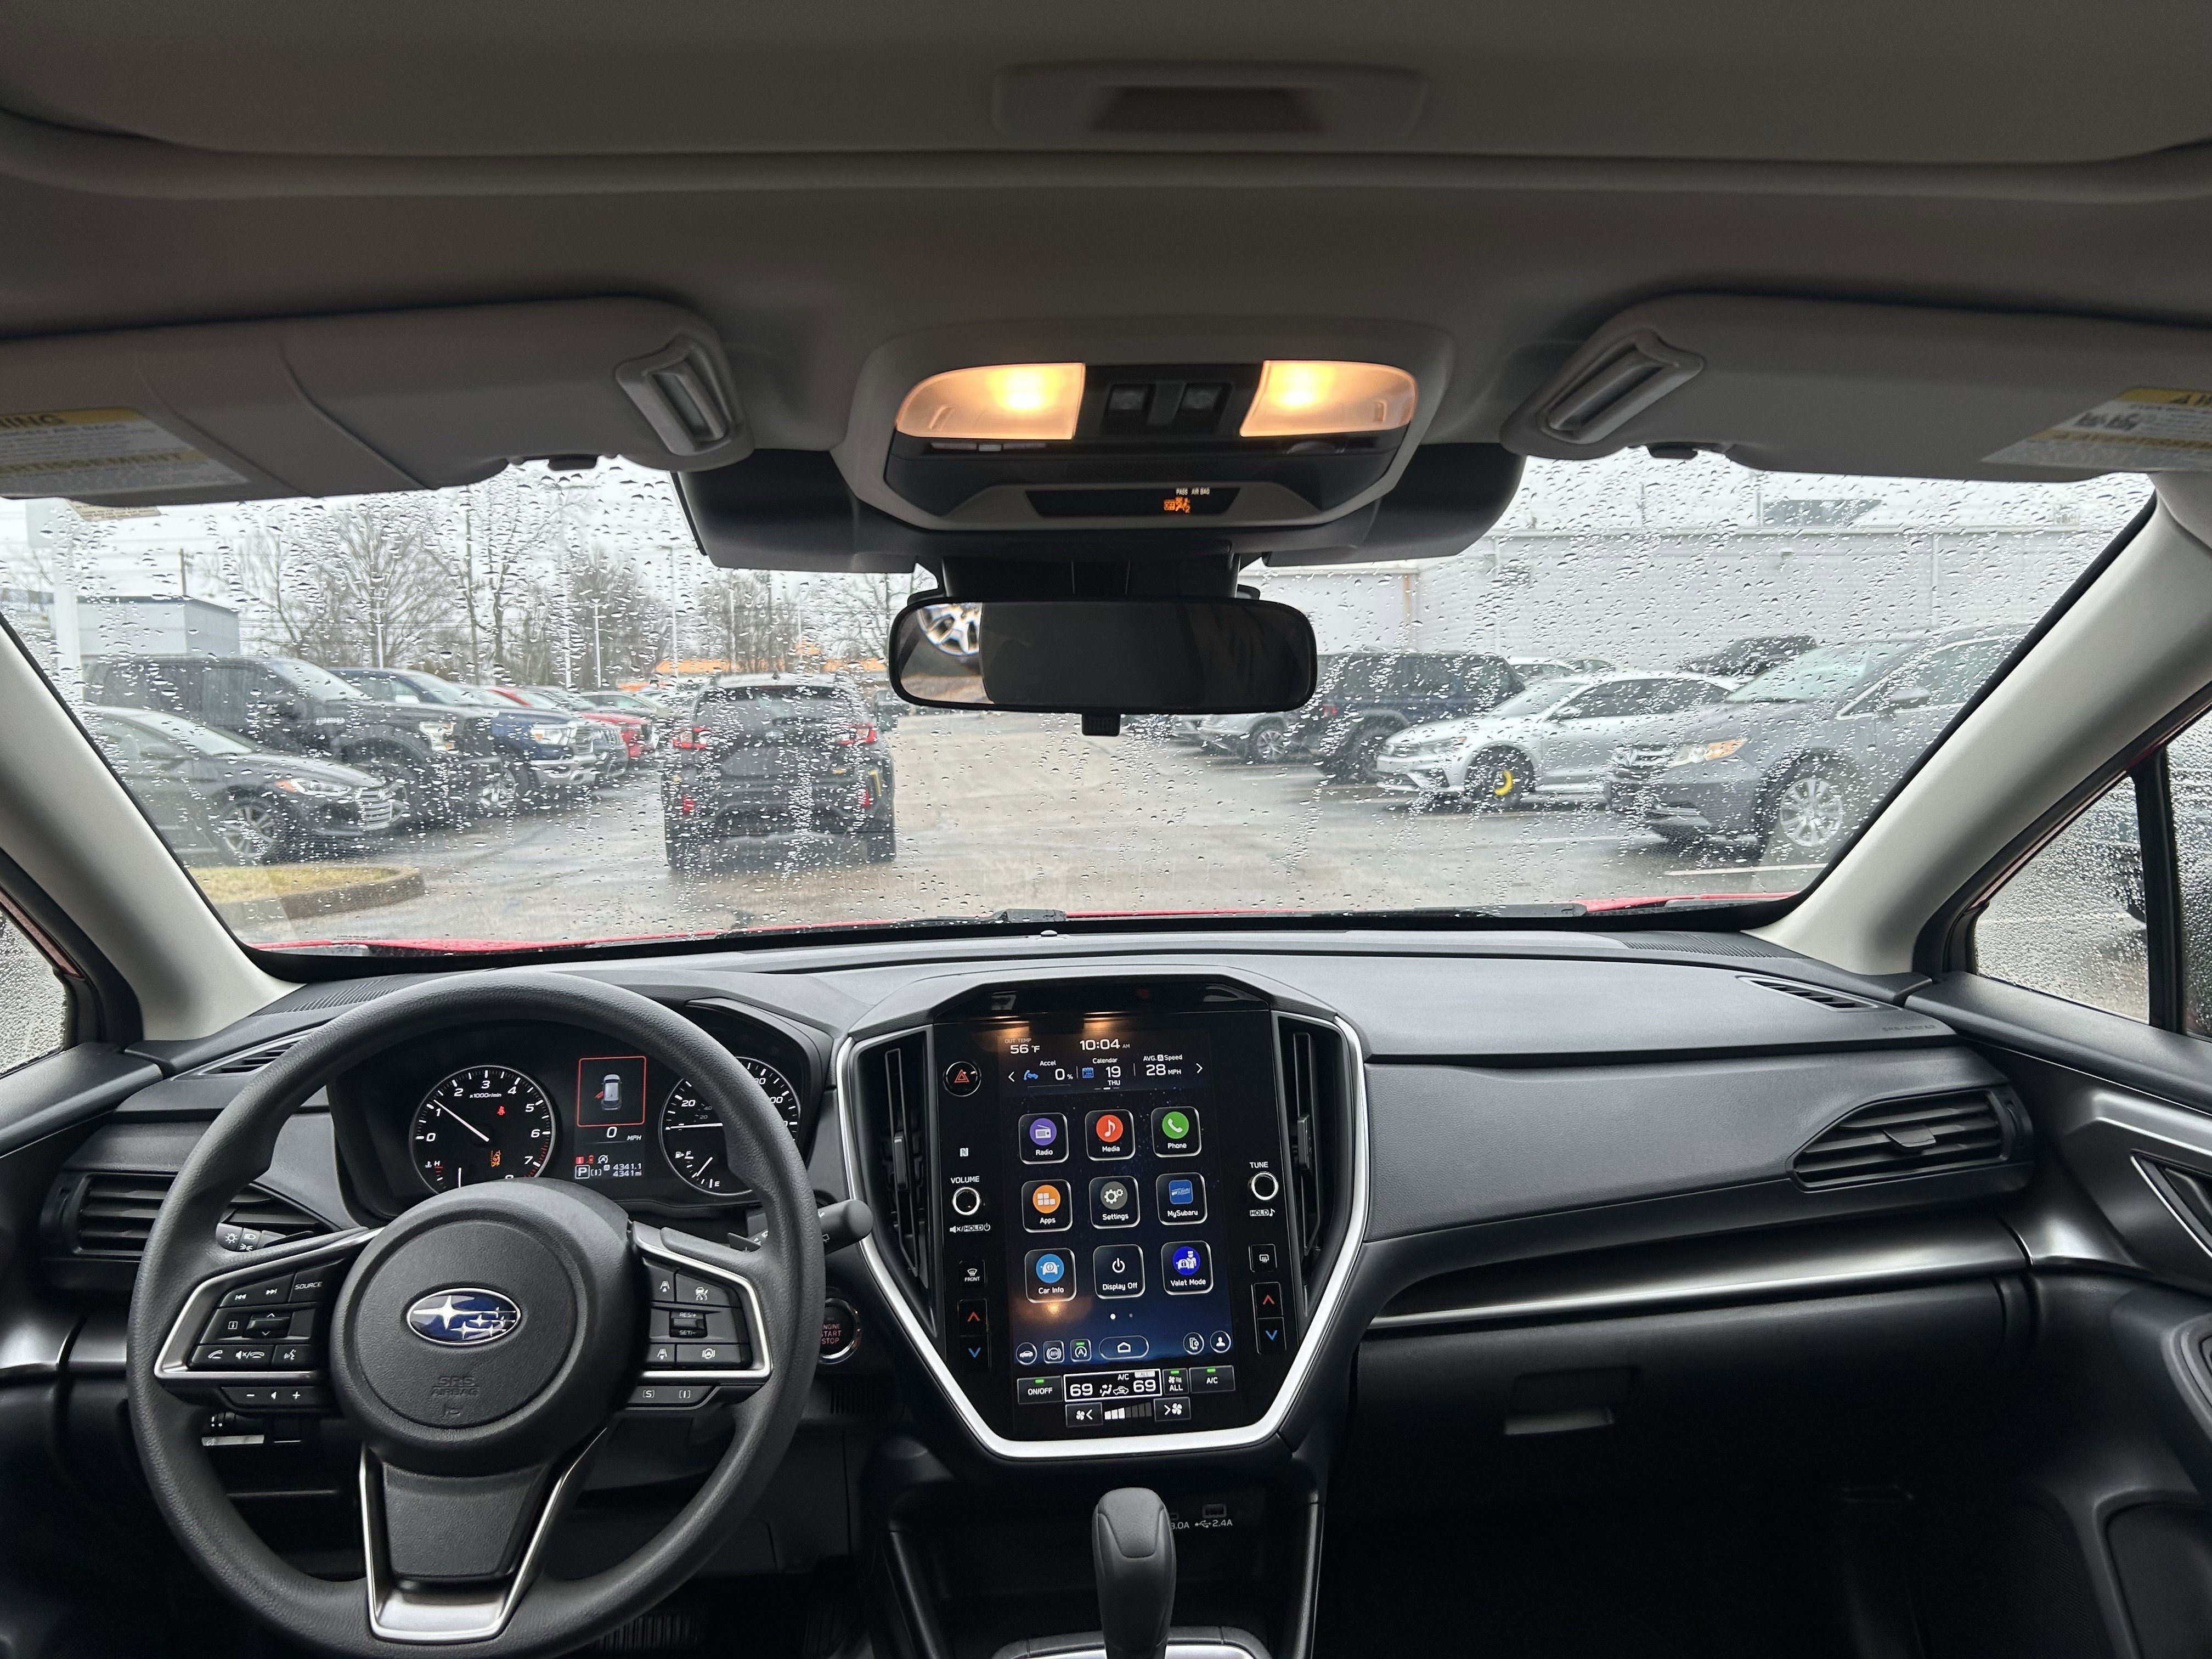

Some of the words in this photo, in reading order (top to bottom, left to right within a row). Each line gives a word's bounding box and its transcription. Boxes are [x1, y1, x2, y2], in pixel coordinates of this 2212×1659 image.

[1165, 502, 1175, 510] OFF
[1010, 1044, 1029, 1054] 56
[1080, 1039, 1120, 1051] 10:04
[1055, 1068, 1065, 1081] 0
[1105, 1065, 1121, 1078] 19
[1146, 1064, 1166, 1076] 28
[481, 1080, 490, 1089] 3
[454, 1088, 464, 1097] 2
[436, 1108, 441, 1116] 1
[525, 1103, 534, 1112] 5
[531, 1129, 540, 1138] 6
[606, 1126, 617, 1138] 0
[426, 1132, 436, 1142] 0
[524, 1155, 533, 1165] 7
[578, 1167, 587, 1176] P
[1167, 1210, 1198, 1218] MySubaru
[295, 1282, 323, 1290] SOURCE
[1102, 1283, 1125, 1291] Display
[1070, 1383, 1093, 1396] 69
[1133, 1379, 1156, 1392] 69
[1028, 1387, 1053, 1396] ON/OFF
